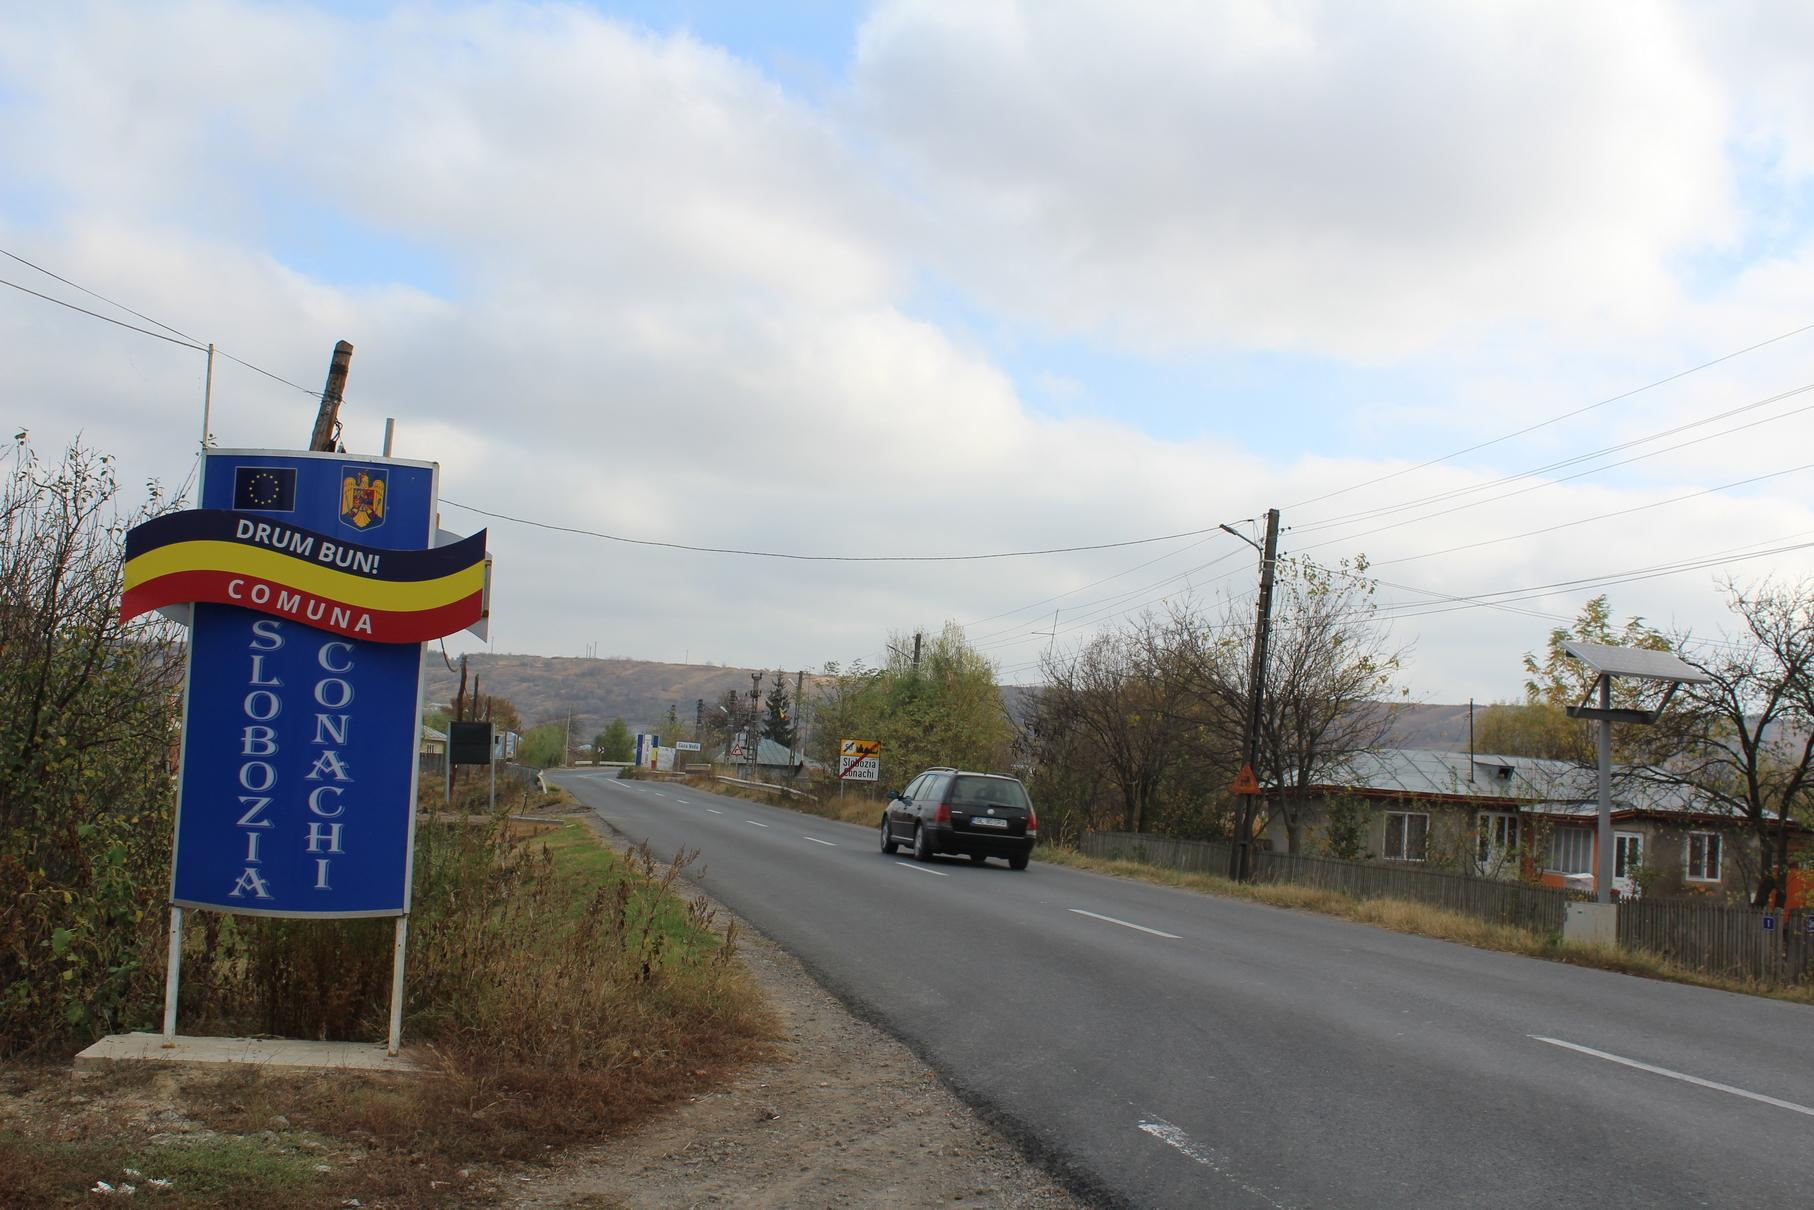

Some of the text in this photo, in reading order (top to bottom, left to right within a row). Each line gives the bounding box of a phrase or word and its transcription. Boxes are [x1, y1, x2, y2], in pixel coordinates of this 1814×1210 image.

[236, 518, 380, 574] DRUM BUN!
[228, 578, 373, 635] COMUNA
[229, 619, 284, 899] SLOBOZIA
[304, 640, 355, 891] CONACHI
[843, 757, 876, 768] Slobozia
